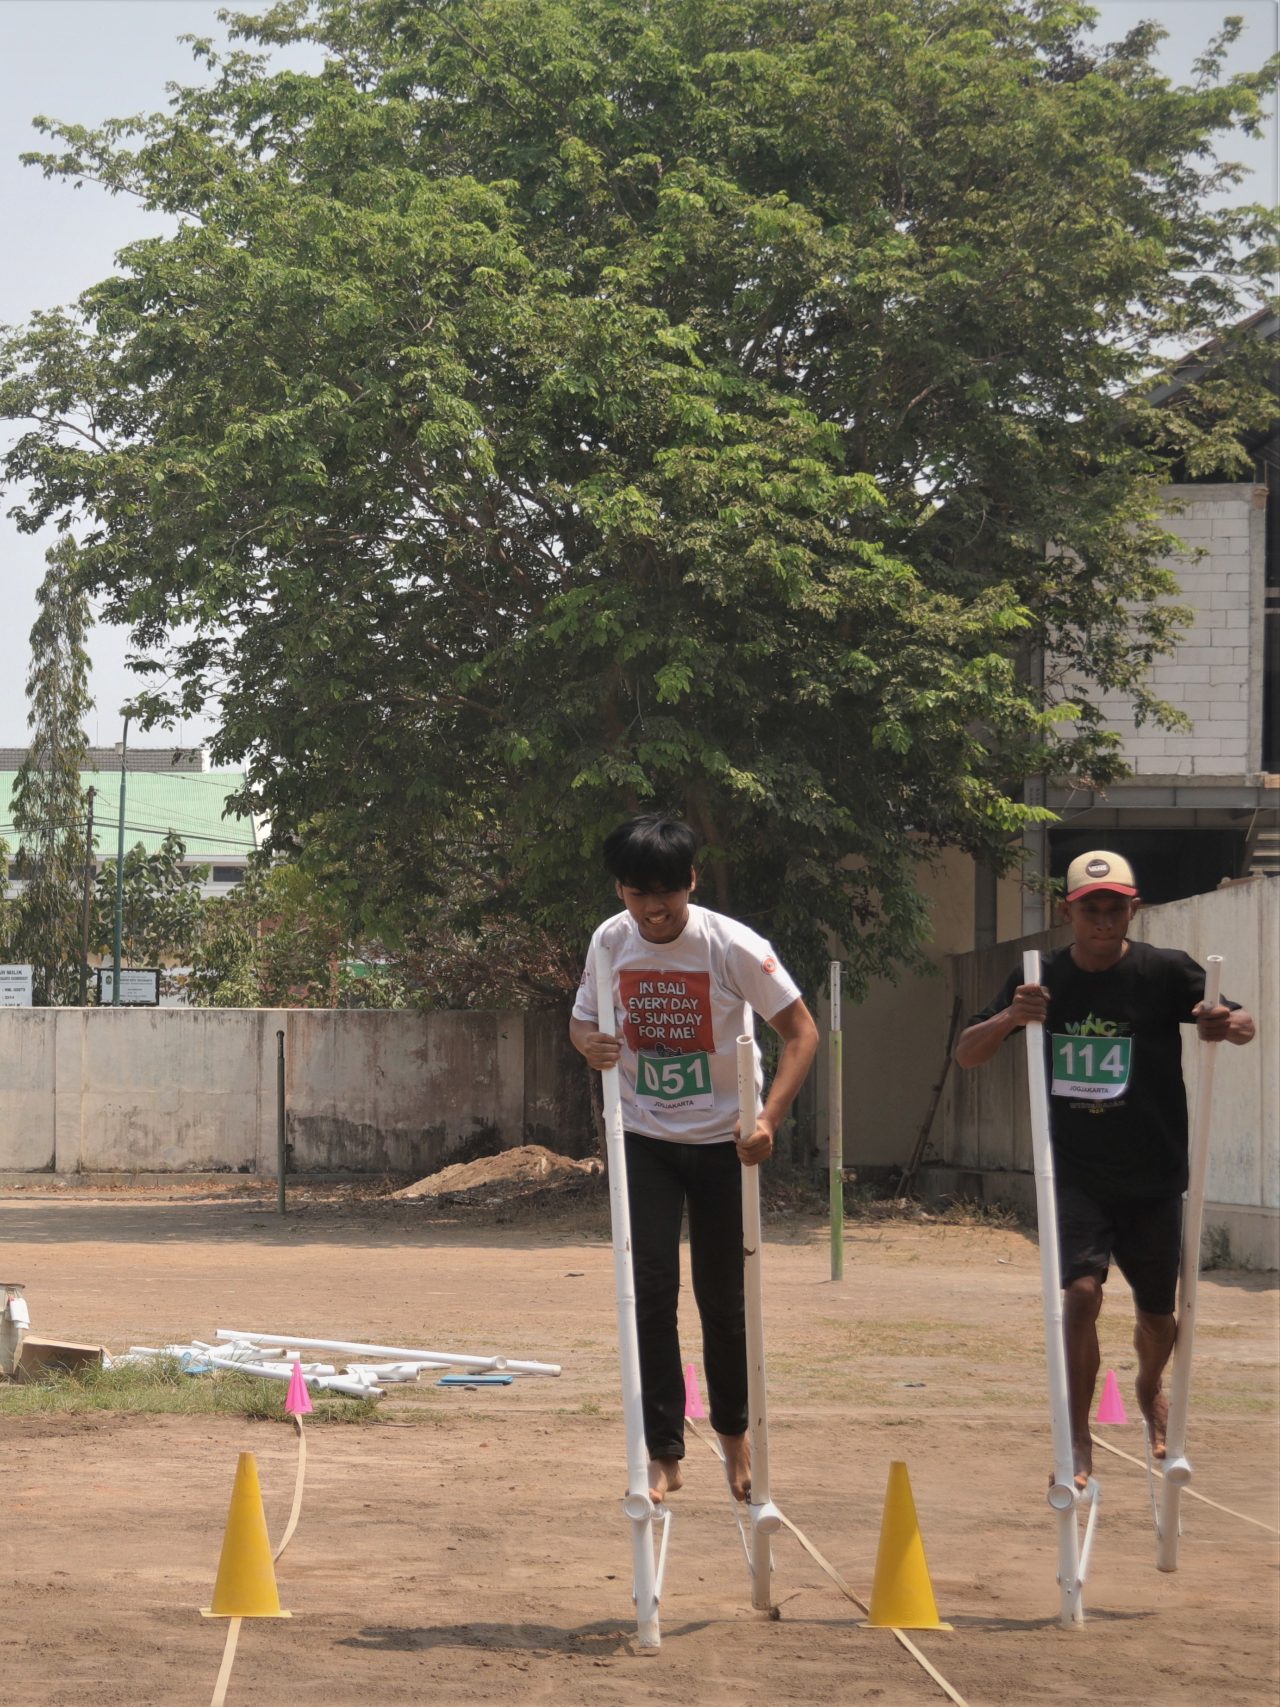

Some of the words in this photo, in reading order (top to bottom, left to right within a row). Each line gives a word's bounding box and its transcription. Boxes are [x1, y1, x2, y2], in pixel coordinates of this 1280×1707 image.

[639, 982, 654, 994] IN
[657, 982, 686, 995] BALI
[629, 997, 668, 1009] EVERY
[671, 998, 698, 1010] DAY
[628, 1012, 641, 1024] IS
[645, 1012, 703, 1026] SUNDAY
[639, 1026, 665, 1038] FOR
[669, 1027, 696, 1039] ME!
[1060, 1042, 1124, 1077] 114
[644, 1058, 704, 1094] 051
[1070, 1085, 1109, 1093] JOGJAKARTA
